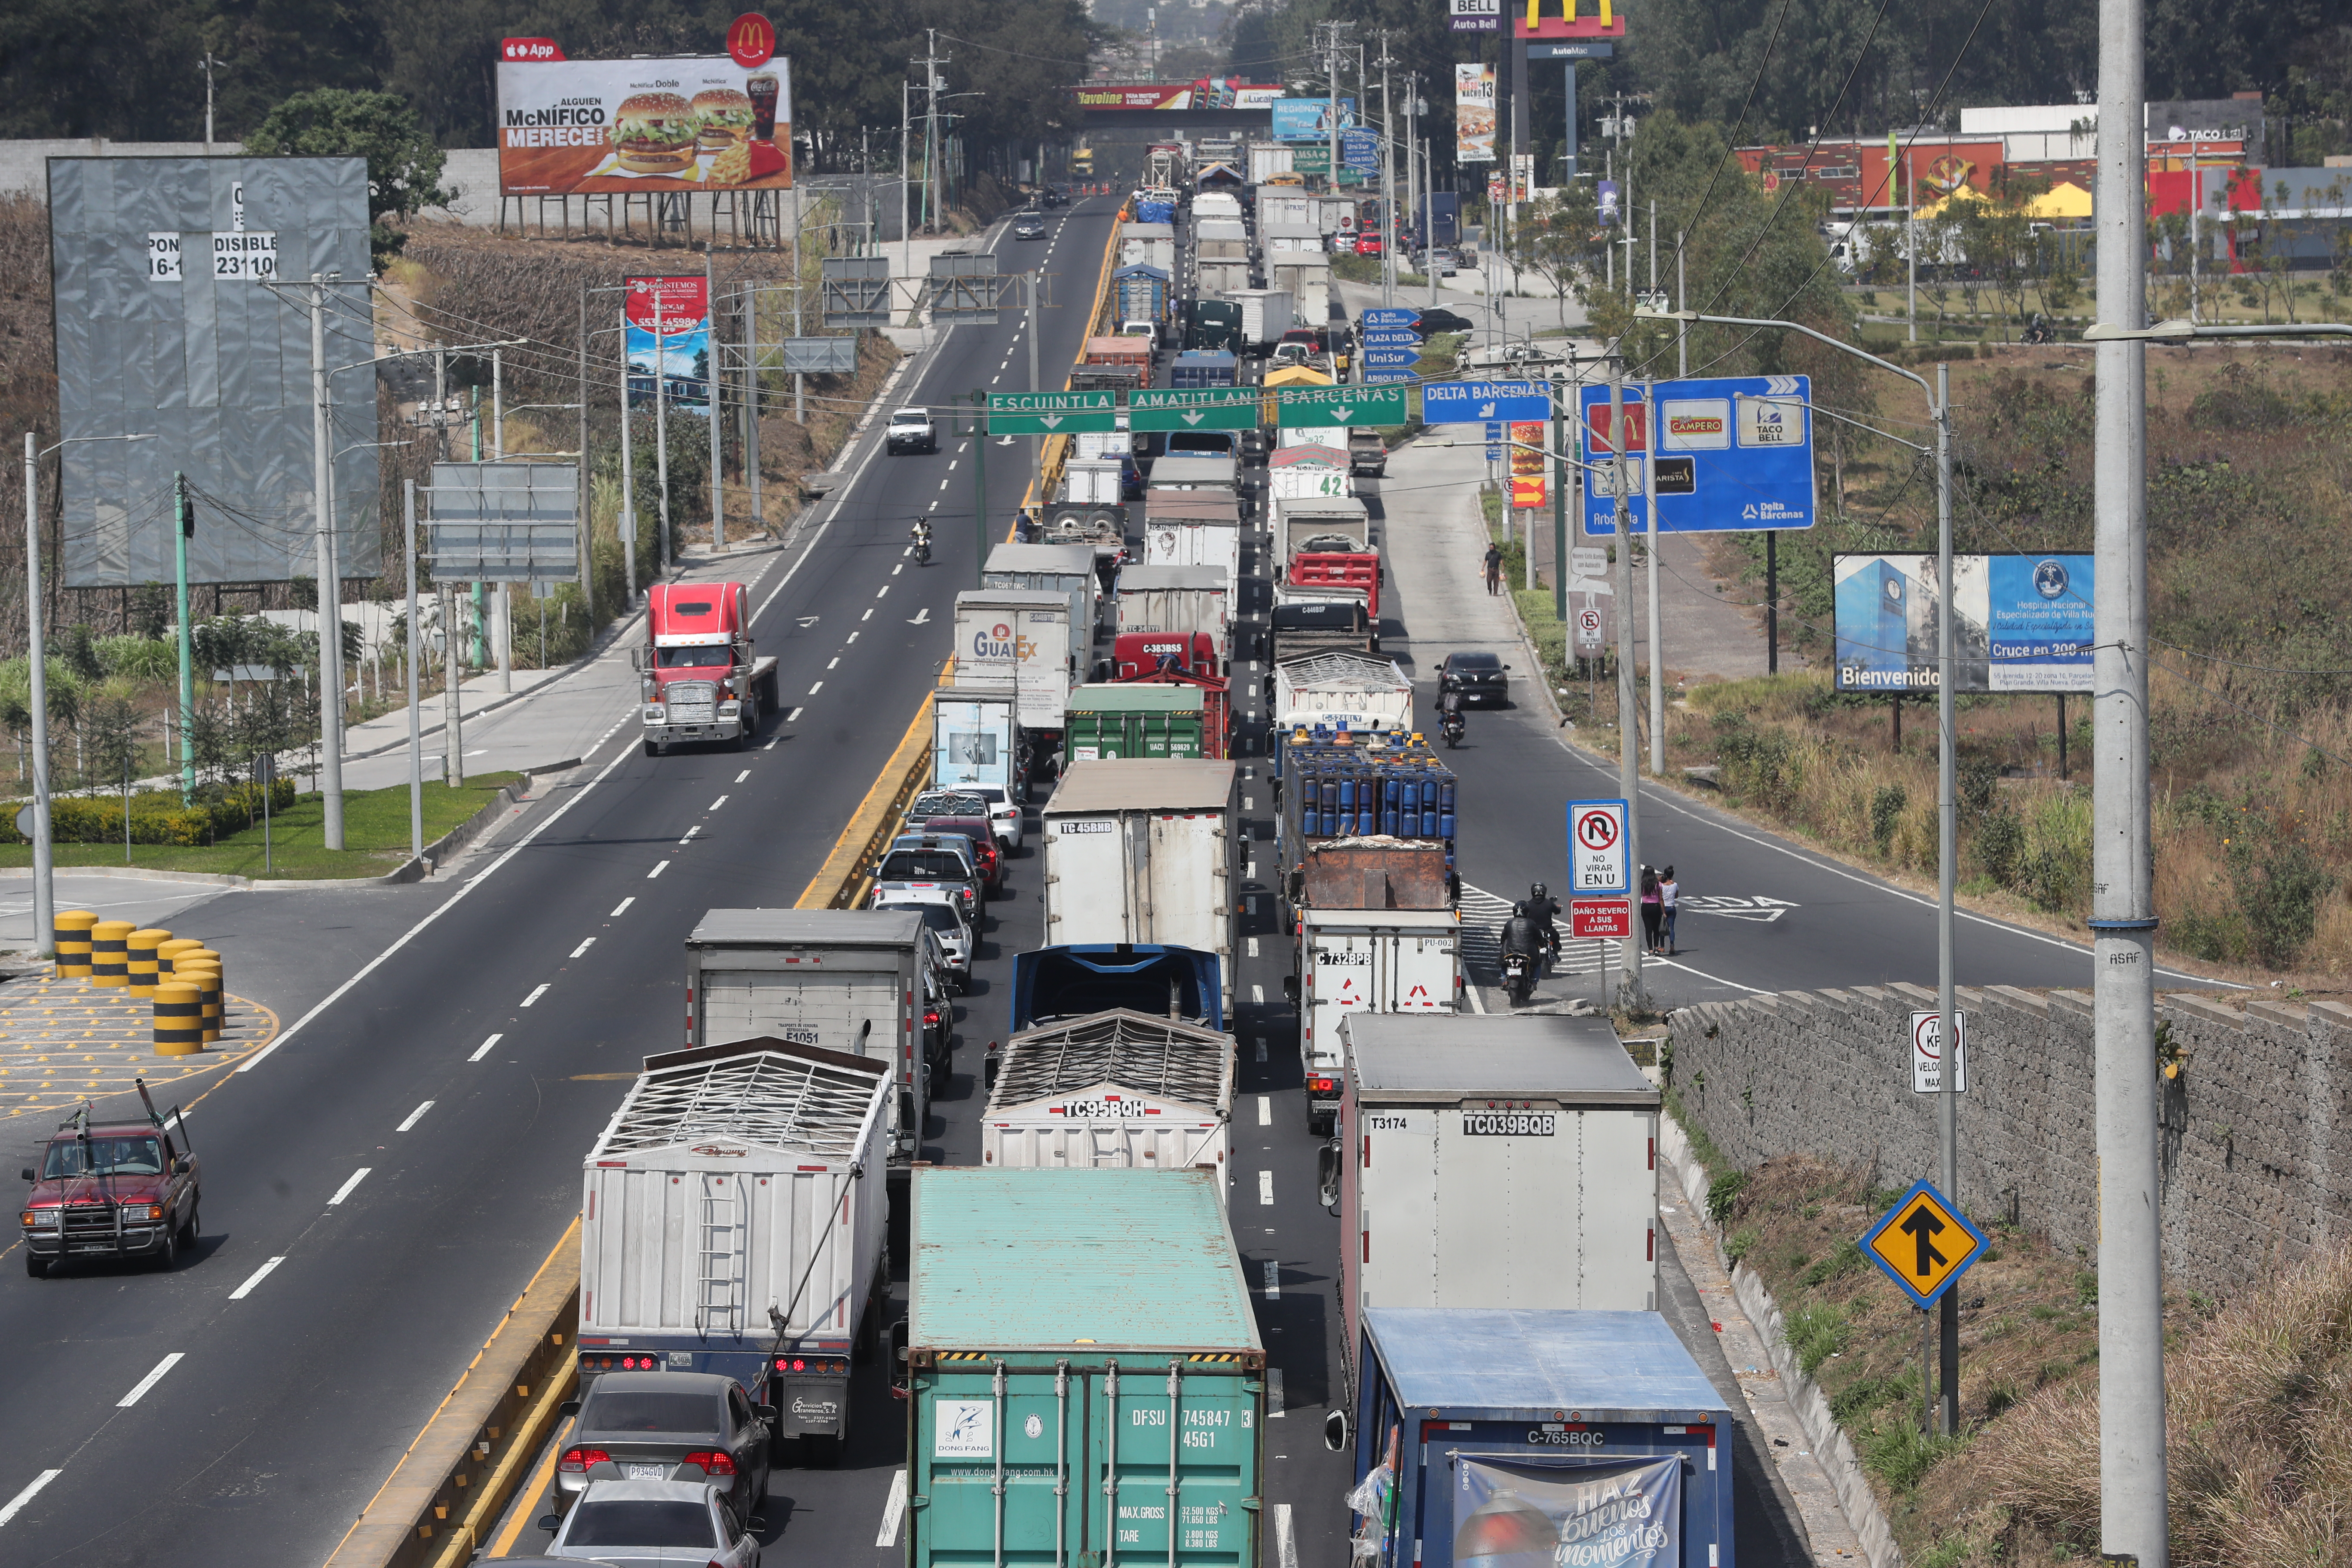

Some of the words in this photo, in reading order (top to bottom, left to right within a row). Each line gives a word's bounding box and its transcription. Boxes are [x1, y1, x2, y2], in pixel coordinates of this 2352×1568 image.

[1458, 0, 1495, 12] BELL
[1454, 20, 1476, 29] Auto
[1479, 19, 1497, 29] Bell
[529, 44, 554, 58] App
[1552, 47, 1587, 55] AutoMac
[655, 80, 679, 88] Doble
[561, 98, 601, 106] ALGUIEN
[506, 104, 605, 126] McNÍFICO
[507, 128, 596, 147] MERECE
[2189, 130, 2220, 140] TACO
[638, 317, 692, 326] 553-4598
[1366, 334, 1390, 342] PLAZA
[1283, 388, 1399, 404] BARCENAS
[1427, 387, 1467, 400] DELTA
[1472, 384, 1544, 400] BARCENAS
[993, 395, 1109, 410] ESCUINTLA
[1136, 392, 1251, 407] AMATITLAN
[1672, 421, 1720, 431] CAMPERO
[1757, 425, 1782, 433] TACO
[1314, 435, 1324, 444] 32
[1320, 476, 1341, 495] 42
[1761, 502, 1785, 511] Delta
[2017, 600, 2049, 611] Hospital
[2052, 600, 2086, 609] Nacional
[1997, 610, 2049, 620] Especializado
[2052, 610, 2061, 619] de
[2063, 610, 2079, 619] Villa
[1143, 643, 1182, 653] C-383BSS
[1993, 643, 2030, 657] Cruce
[2034, 646, 2049, 656] en
[2052, 643, 2076, 657] 200
[1842, 666, 1940, 686] Bienvenido
[1062, 823, 1075, 833] TC
[1077, 823, 1112, 833] 45BHB
[1585, 873, 1602, 885] EN
[1607, 873, 1614, 884] U
[2094, 883, 2109, 894] SAF
[1574, 906, 1595, 915] DAÑO
[1317, 953, 1325, 965] C
[1329, 952, 1371, 965] 732BPB
[2110, 952, 2141, 965] ASAF
[1927, 1035, 1940, 1047] KP
[1918, 1062, 1959, 1072] VELOCD
[1064, 1101, 1145, 1117] TC95BQH
[1371, 1118, 1406, 1130] T3174
[1466, 1116, 1553, 1134] TC039BQB
[1133, 1410, 1165, 1425] DFSU
[1183, 1410, 1231, 1426] 745847
[1244, 1411, 1251, 1427] 3
[1183, 1431, 1215, 1447] 45G1
[1528, 1431, 1603, 1446] C-765BQC
[631, 1467, 662, 1476] P934GVD
[951, 1467, 1054, 1478] www.dongfang.com.hk
[1576, 1473, 1644, 1516] HAZ
[1205, 1507, 1219, 1515] KGS
[1205, 1515, 1218, 1524] LBS
[1561, 1494, 1651, 1543] buenos
[1119, 1530, 1139, 1542] TARE
[1205, 1530, 1218, 1538] KGS
[1597, 1523, 1628, 1543] LOS
[1205, 1539, 1217, 1547] LBS
[1555, 1520, 1669, 1566] momentos
